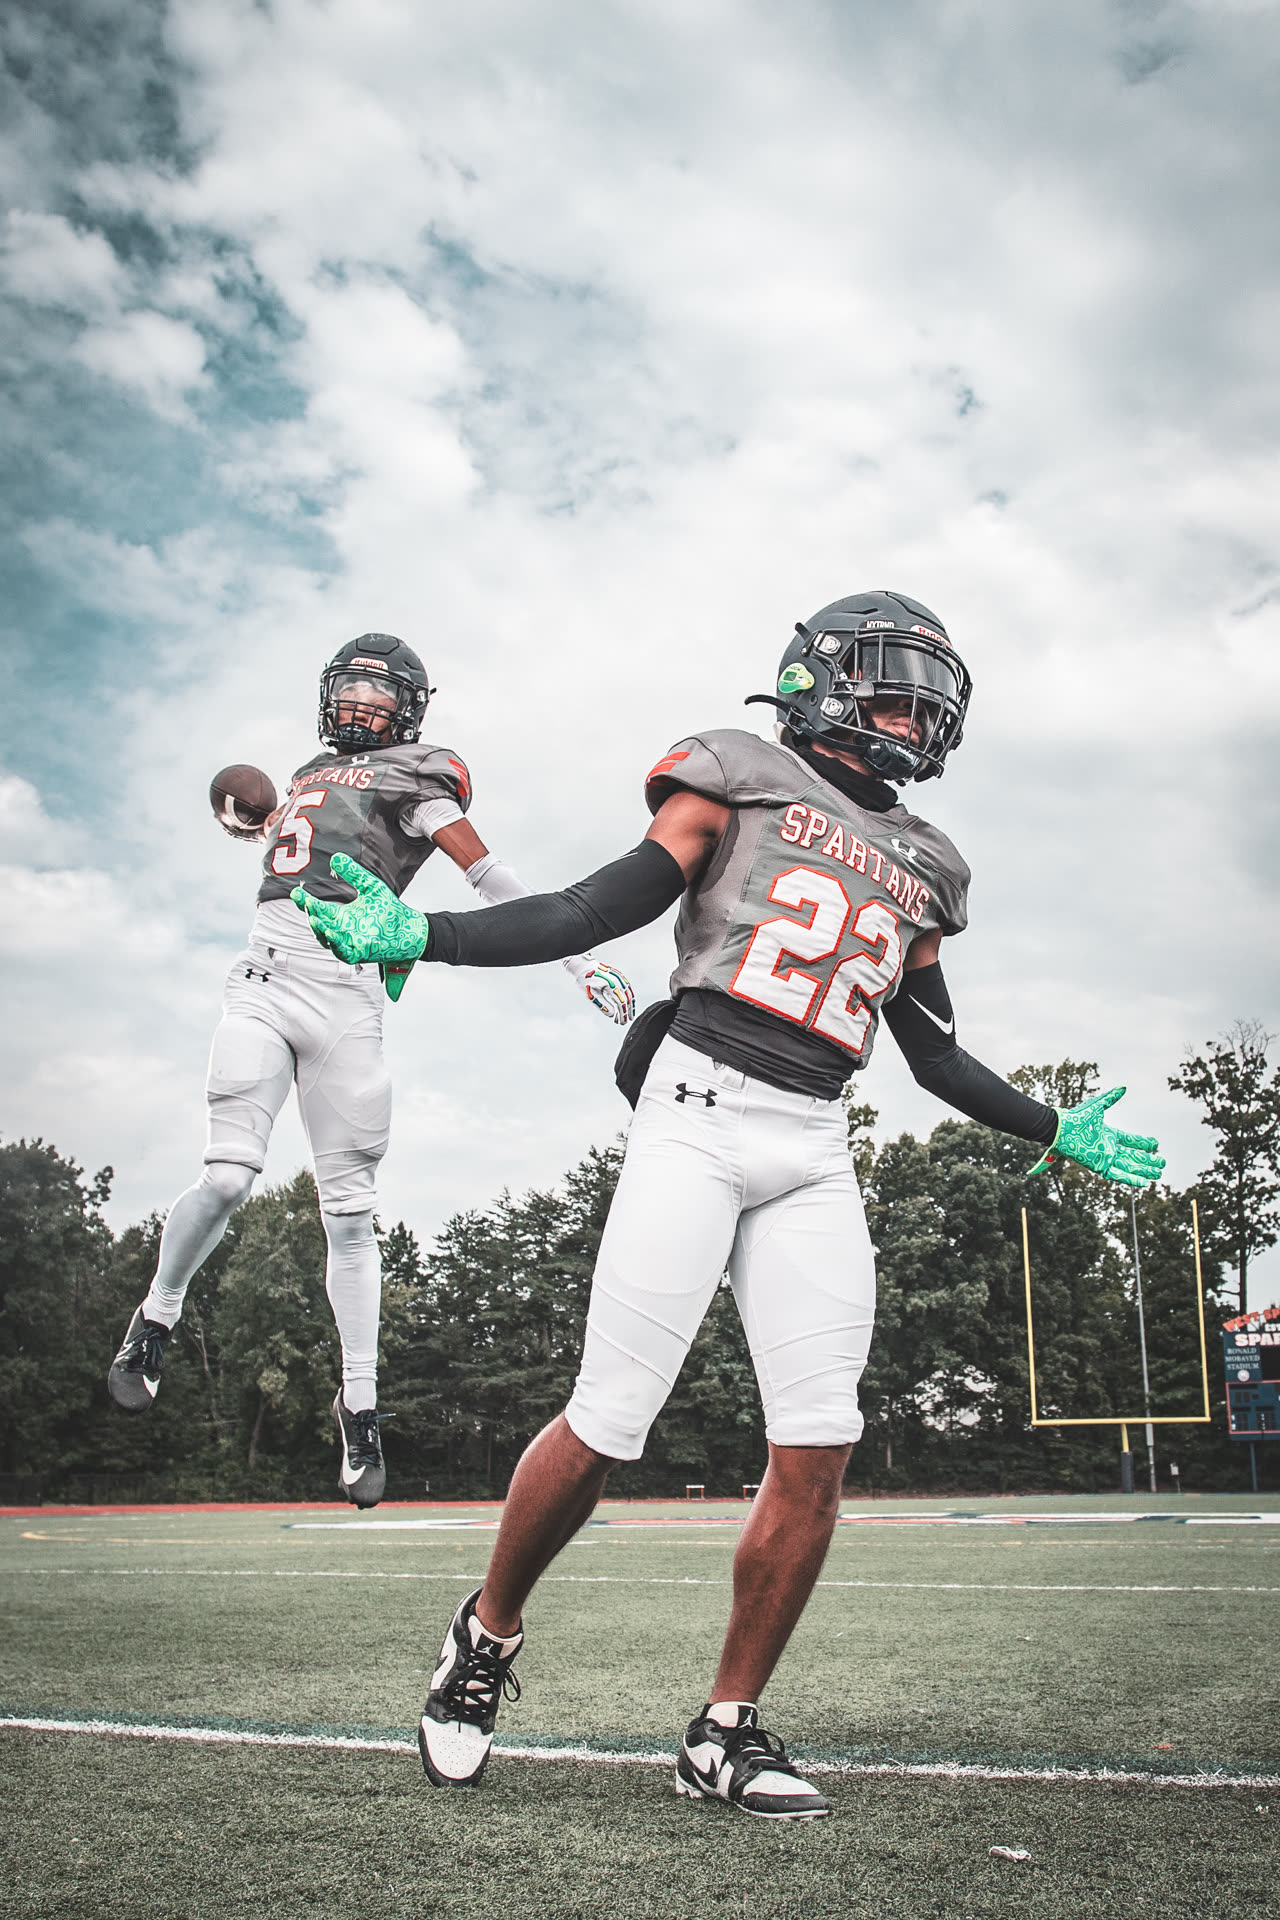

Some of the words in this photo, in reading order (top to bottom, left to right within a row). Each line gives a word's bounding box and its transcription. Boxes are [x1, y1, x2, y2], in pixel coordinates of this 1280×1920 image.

[270, 789, 328, 875] 5
[779, 802, 930, 925] SPARTANS
[727, 864, 903, 1056] 22
